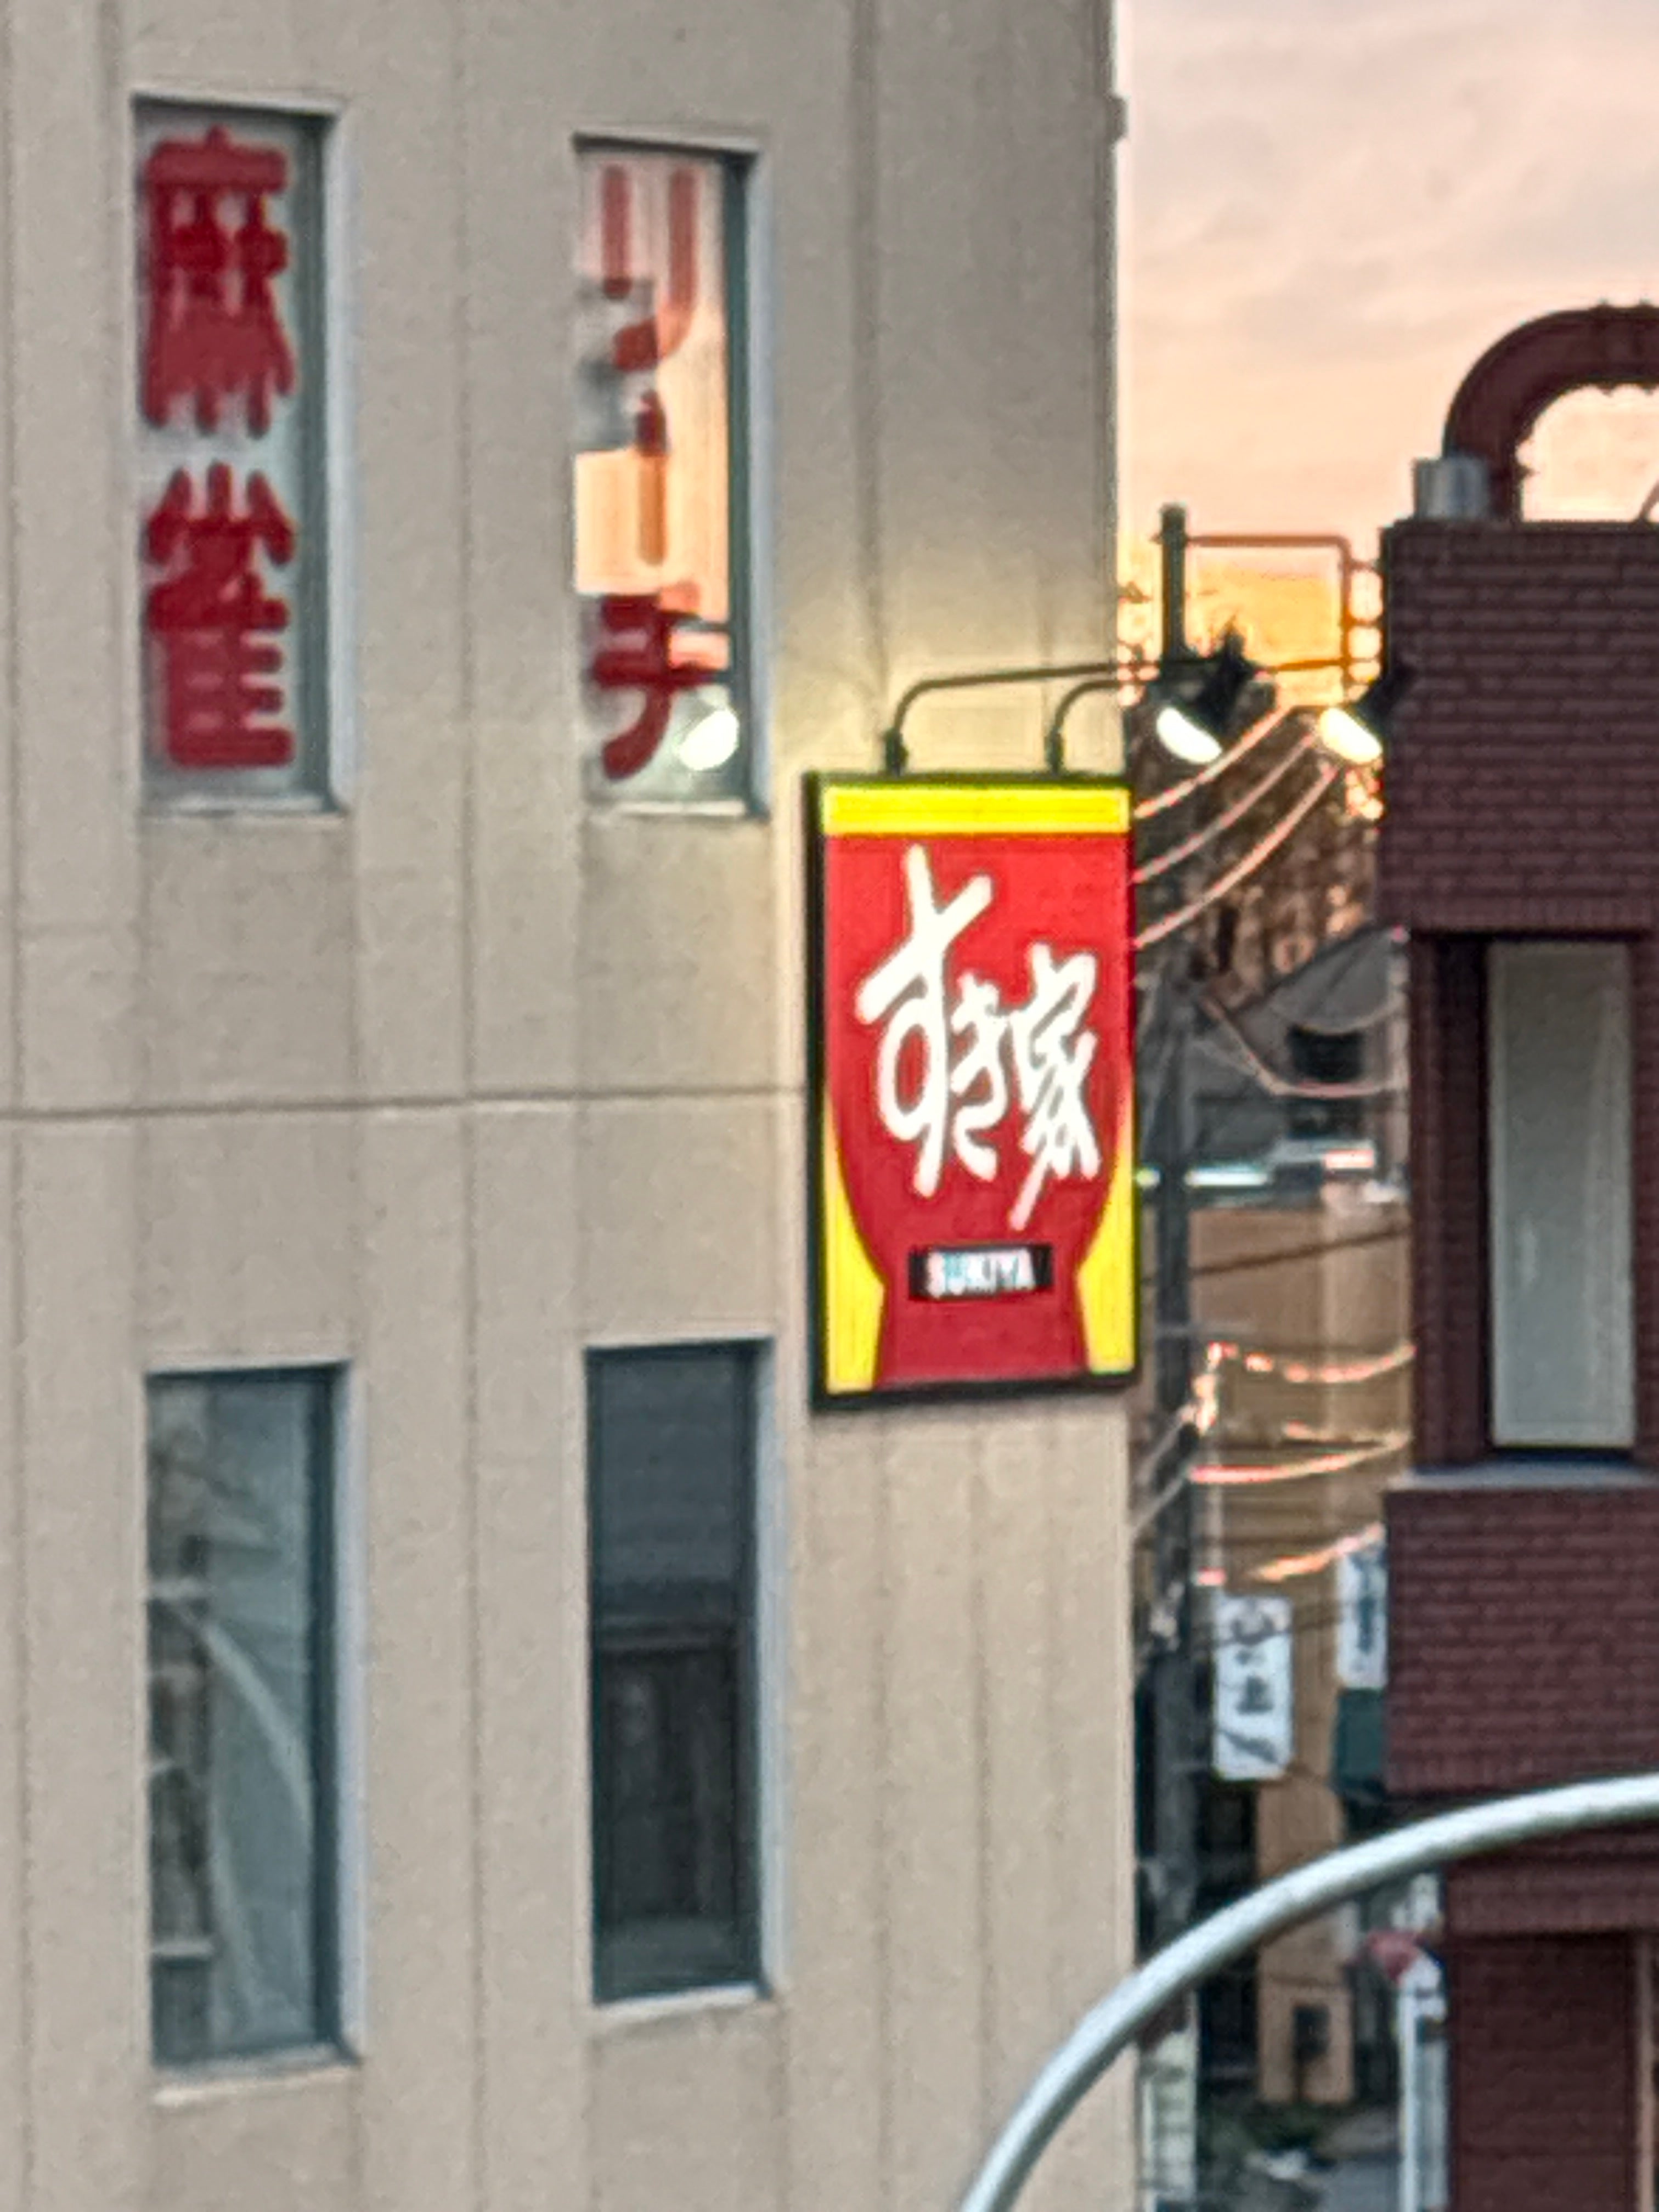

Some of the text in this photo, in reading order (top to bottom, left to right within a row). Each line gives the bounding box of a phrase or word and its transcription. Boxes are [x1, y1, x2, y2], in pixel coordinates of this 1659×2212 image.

[143, 125, 296, 769] 麻雀
[854, 842, 1102, 1232] すき家
[926, 1247, 1036, 1299] SUKIYA
